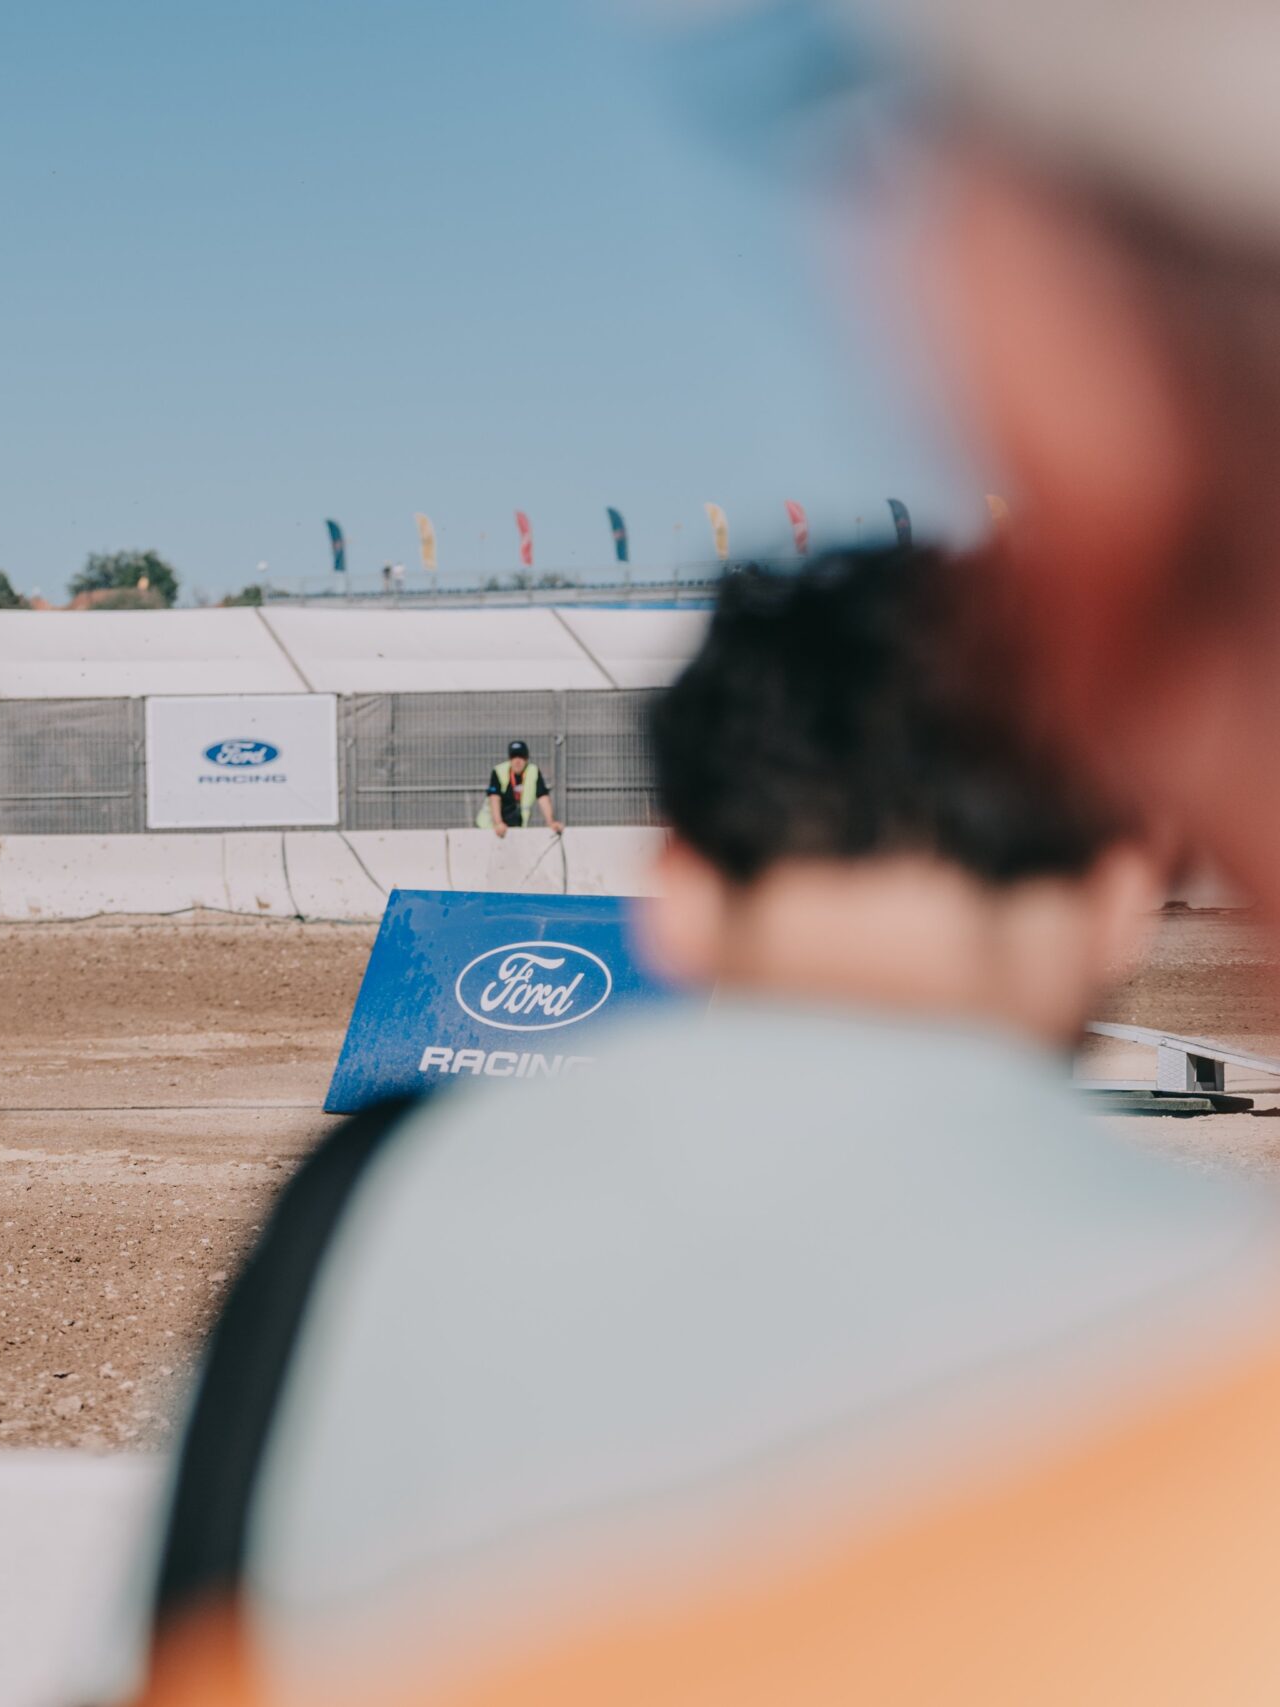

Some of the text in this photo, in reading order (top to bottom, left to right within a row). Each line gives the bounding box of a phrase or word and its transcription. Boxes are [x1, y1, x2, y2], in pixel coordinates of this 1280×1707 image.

[216, 741, 267, 764] Ford
[198, 774, 287, 784] RACING
[480, 952, 584, 1017] Ford
